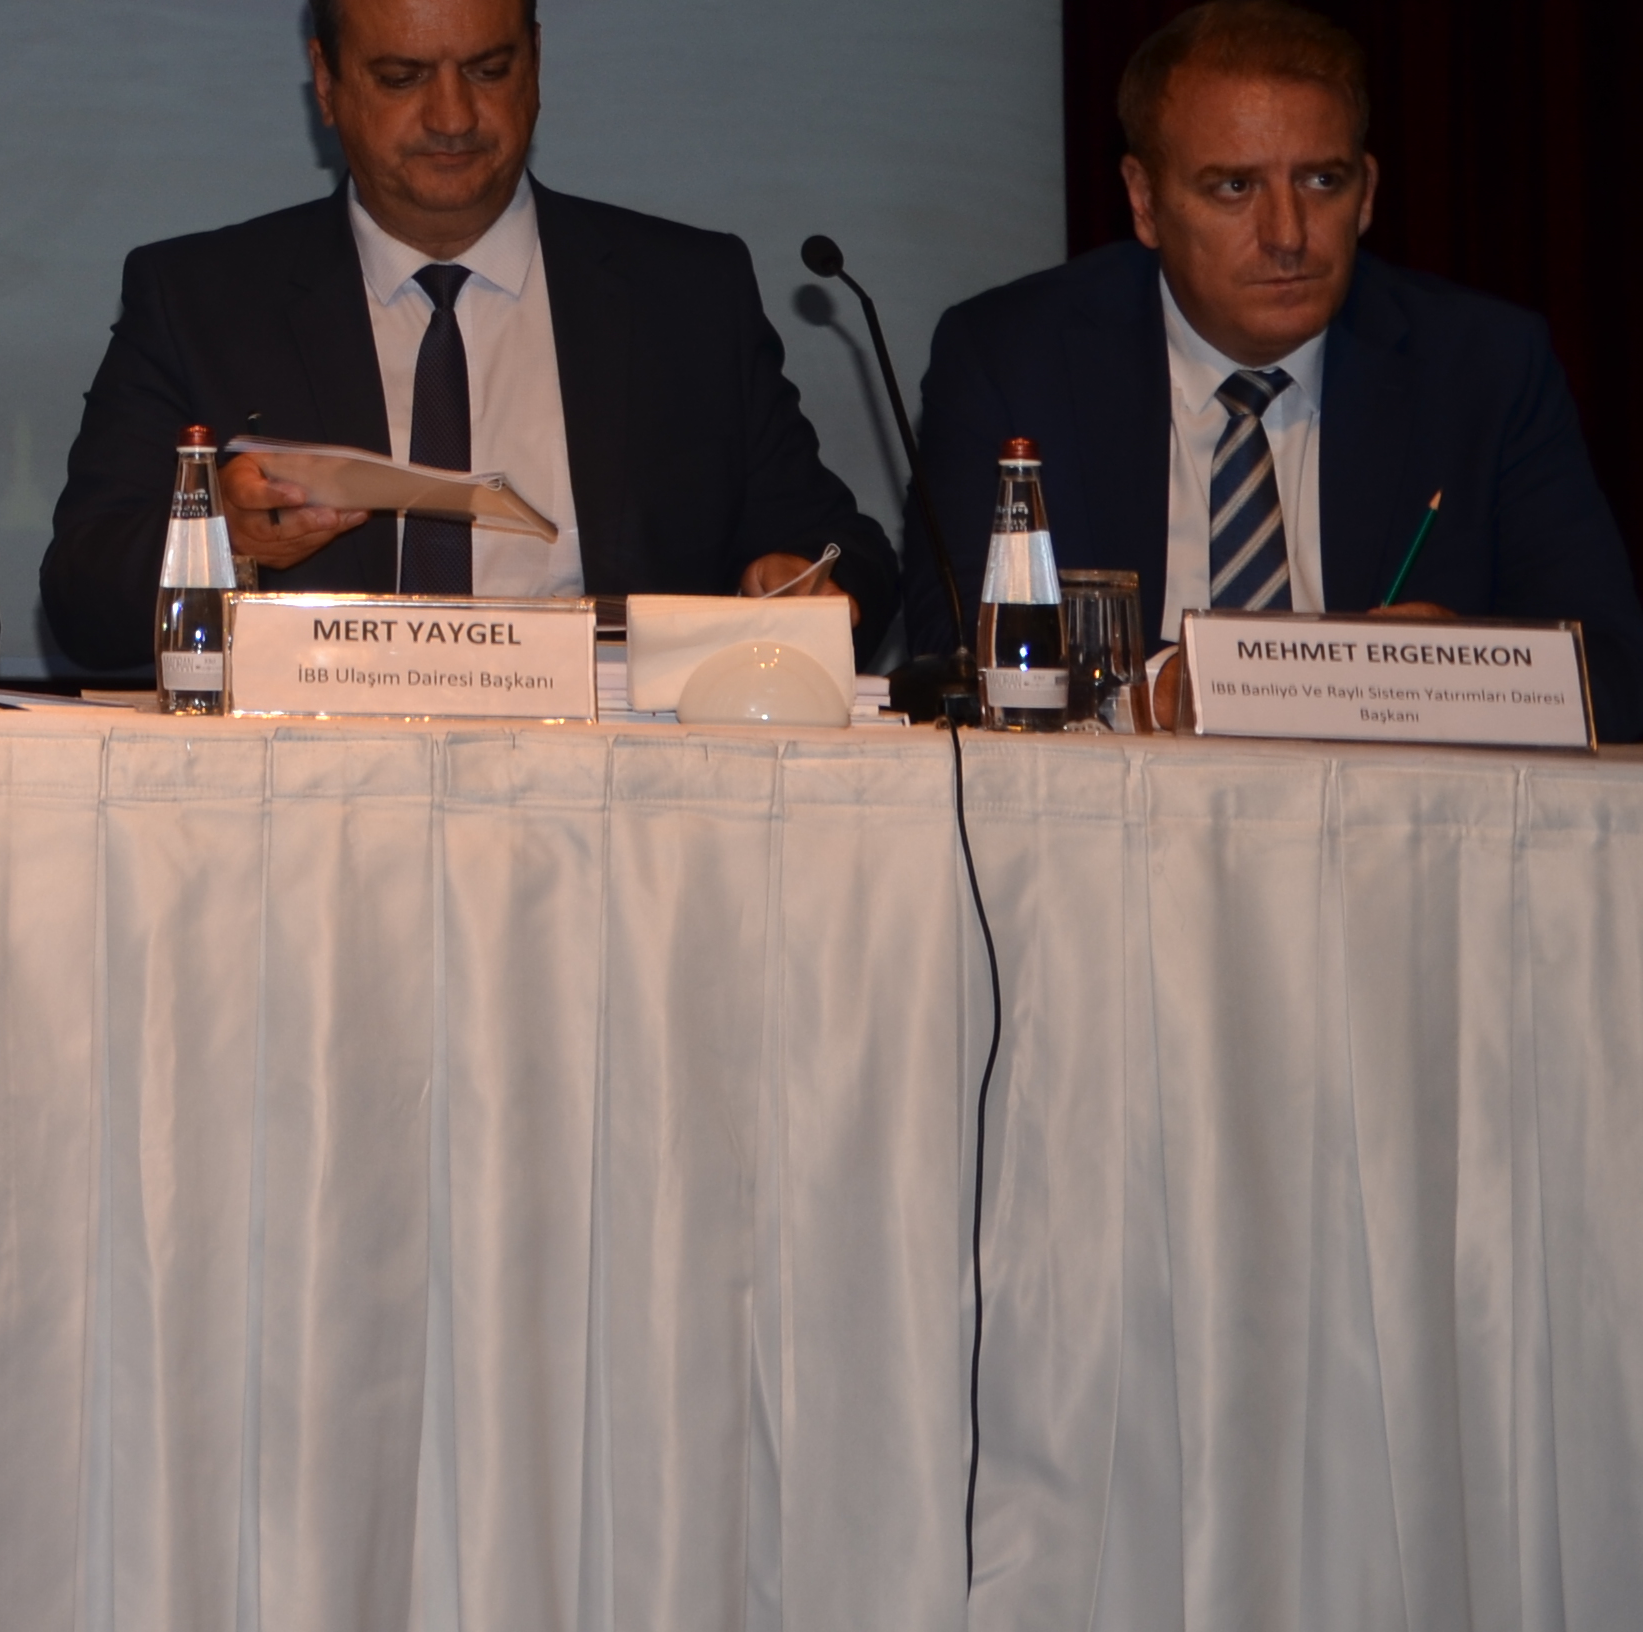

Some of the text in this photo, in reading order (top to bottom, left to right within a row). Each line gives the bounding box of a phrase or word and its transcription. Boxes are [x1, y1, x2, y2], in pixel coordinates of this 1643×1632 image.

[313, 618, 521, 646] MERT YAYGEL
[1237, 640, 1532, 667] MEHMET ERGENEKON
[298, 664, 555, 693] İBB Ulaşım Dairesi Başkanı
[1210, 680, 1237, 697] İBB
[1302, 685, 1323, 700] Ve
[1327, 685, 1364, 704] Raylı
[1368, 686, 1420, 703] Sistem
[1424, 687, 1508, 705] Yatırımları
[1510, 689, 1565, 706] Dairesi
[1360, 707, 1420, 726] Başkanı
